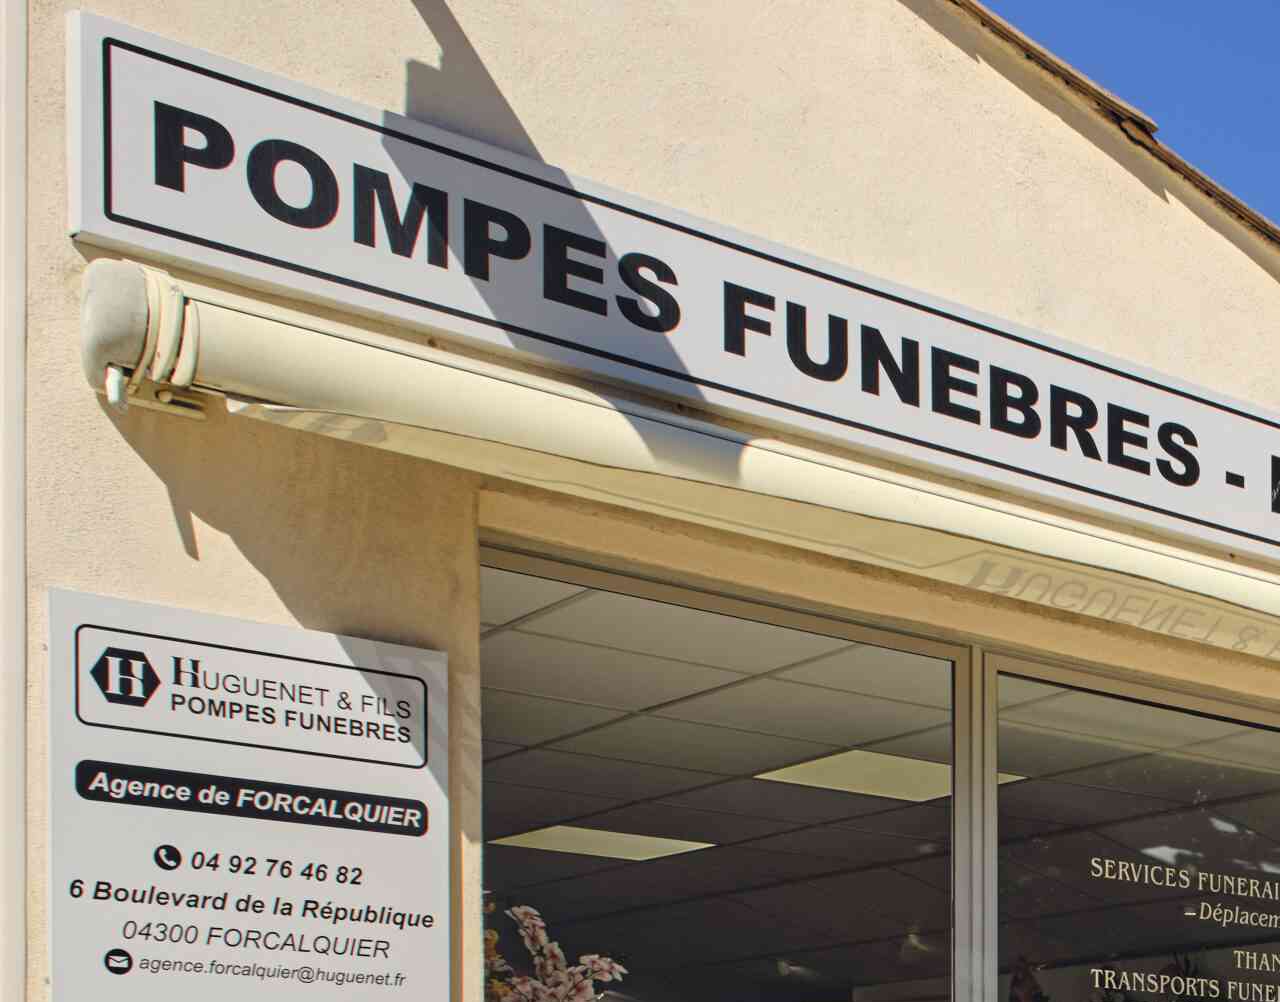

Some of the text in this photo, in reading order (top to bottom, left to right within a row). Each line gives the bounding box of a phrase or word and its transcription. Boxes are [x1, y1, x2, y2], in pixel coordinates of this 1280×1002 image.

[154, 100, 681, 333] POMPES
[723, 280, 1200, 488] FUNEBRES
[1225, 472, 1245, 488] -
[171, 656, 412, 720] HUGUENET & FILS
[171, 693, 412, 744] POMPES FUNEBRES
[88, 771, 422, 829] Agence de FORCALQUIER
[190, 851, 364, 886] 04 92 76 46 82
[1090, 857, 1192, 889] SERVICES
[69, 878, 435, 930] 6 Boulevard de la République
[122, 919, 391, 960] 04300 FORCALQUIER
[138, 955, 407, 988] agence.forcalquier@huguenet.fr
[1090, 968, 1221, 999] TRANSPORTS
